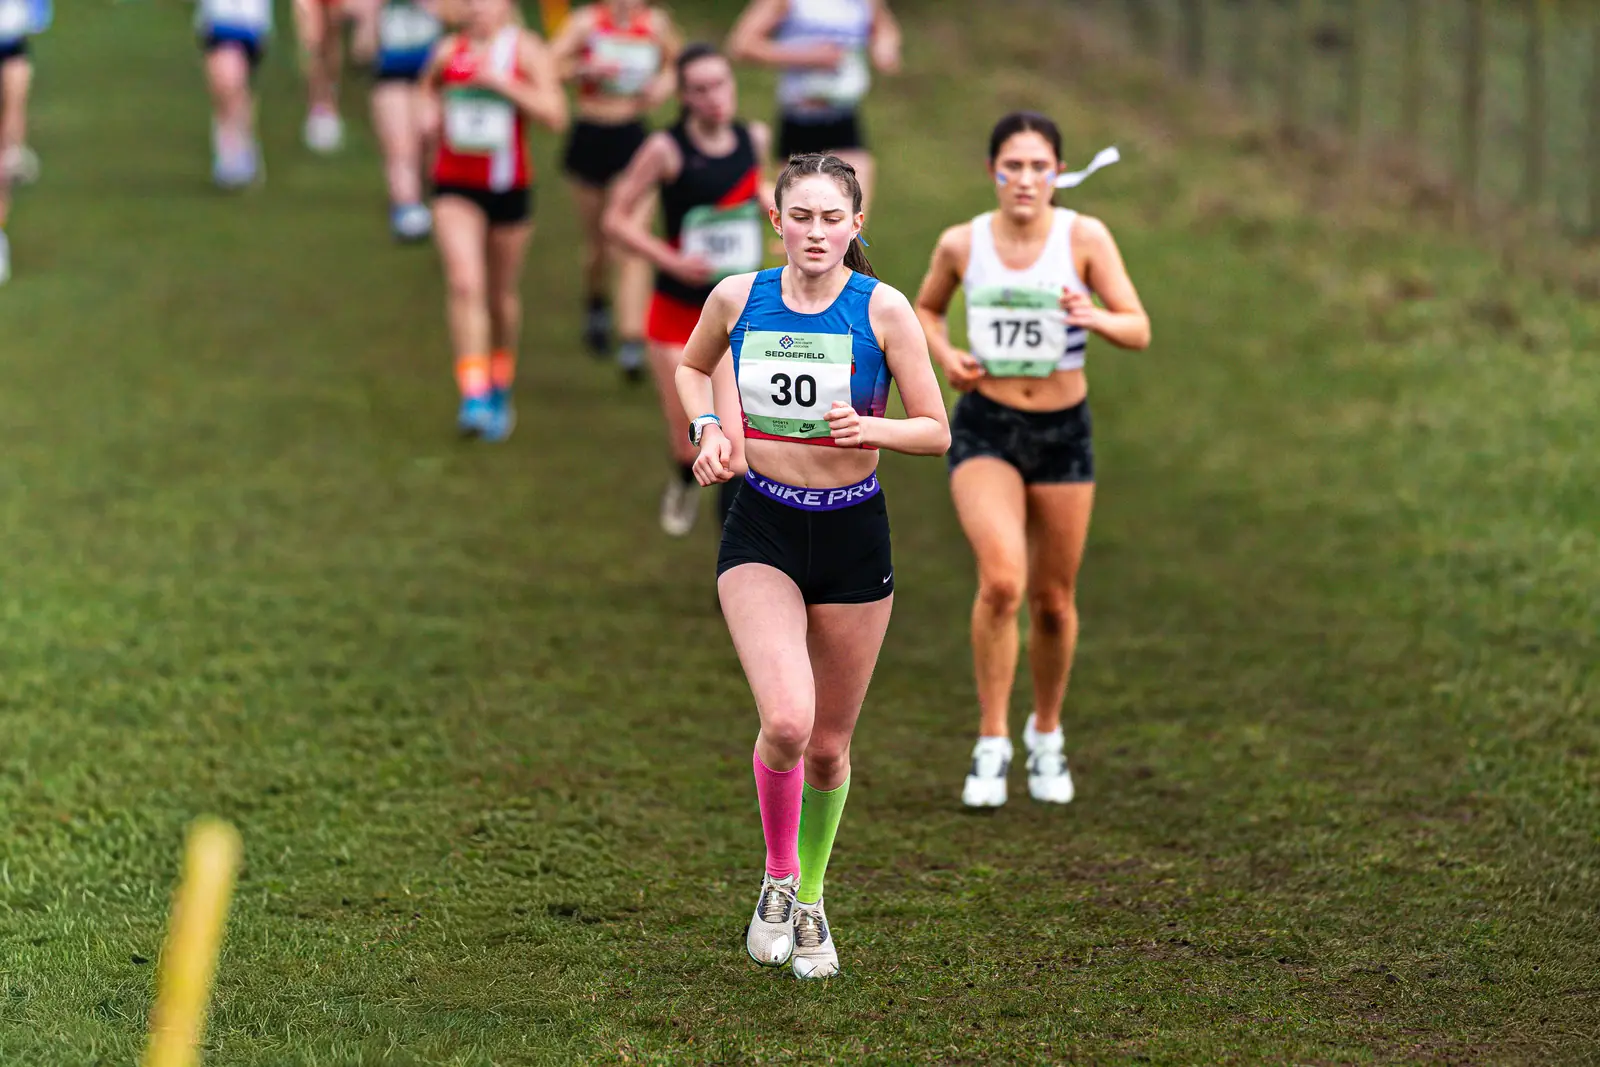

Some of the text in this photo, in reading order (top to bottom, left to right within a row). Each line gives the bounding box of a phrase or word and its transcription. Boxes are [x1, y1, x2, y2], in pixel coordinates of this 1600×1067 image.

[991, 320, 1042, 348] 175
[765, 350, 825, 360] SEDGEFIELD
[770, 373, 816, 407] 30
[759, 479, 824, 506] NIKE
